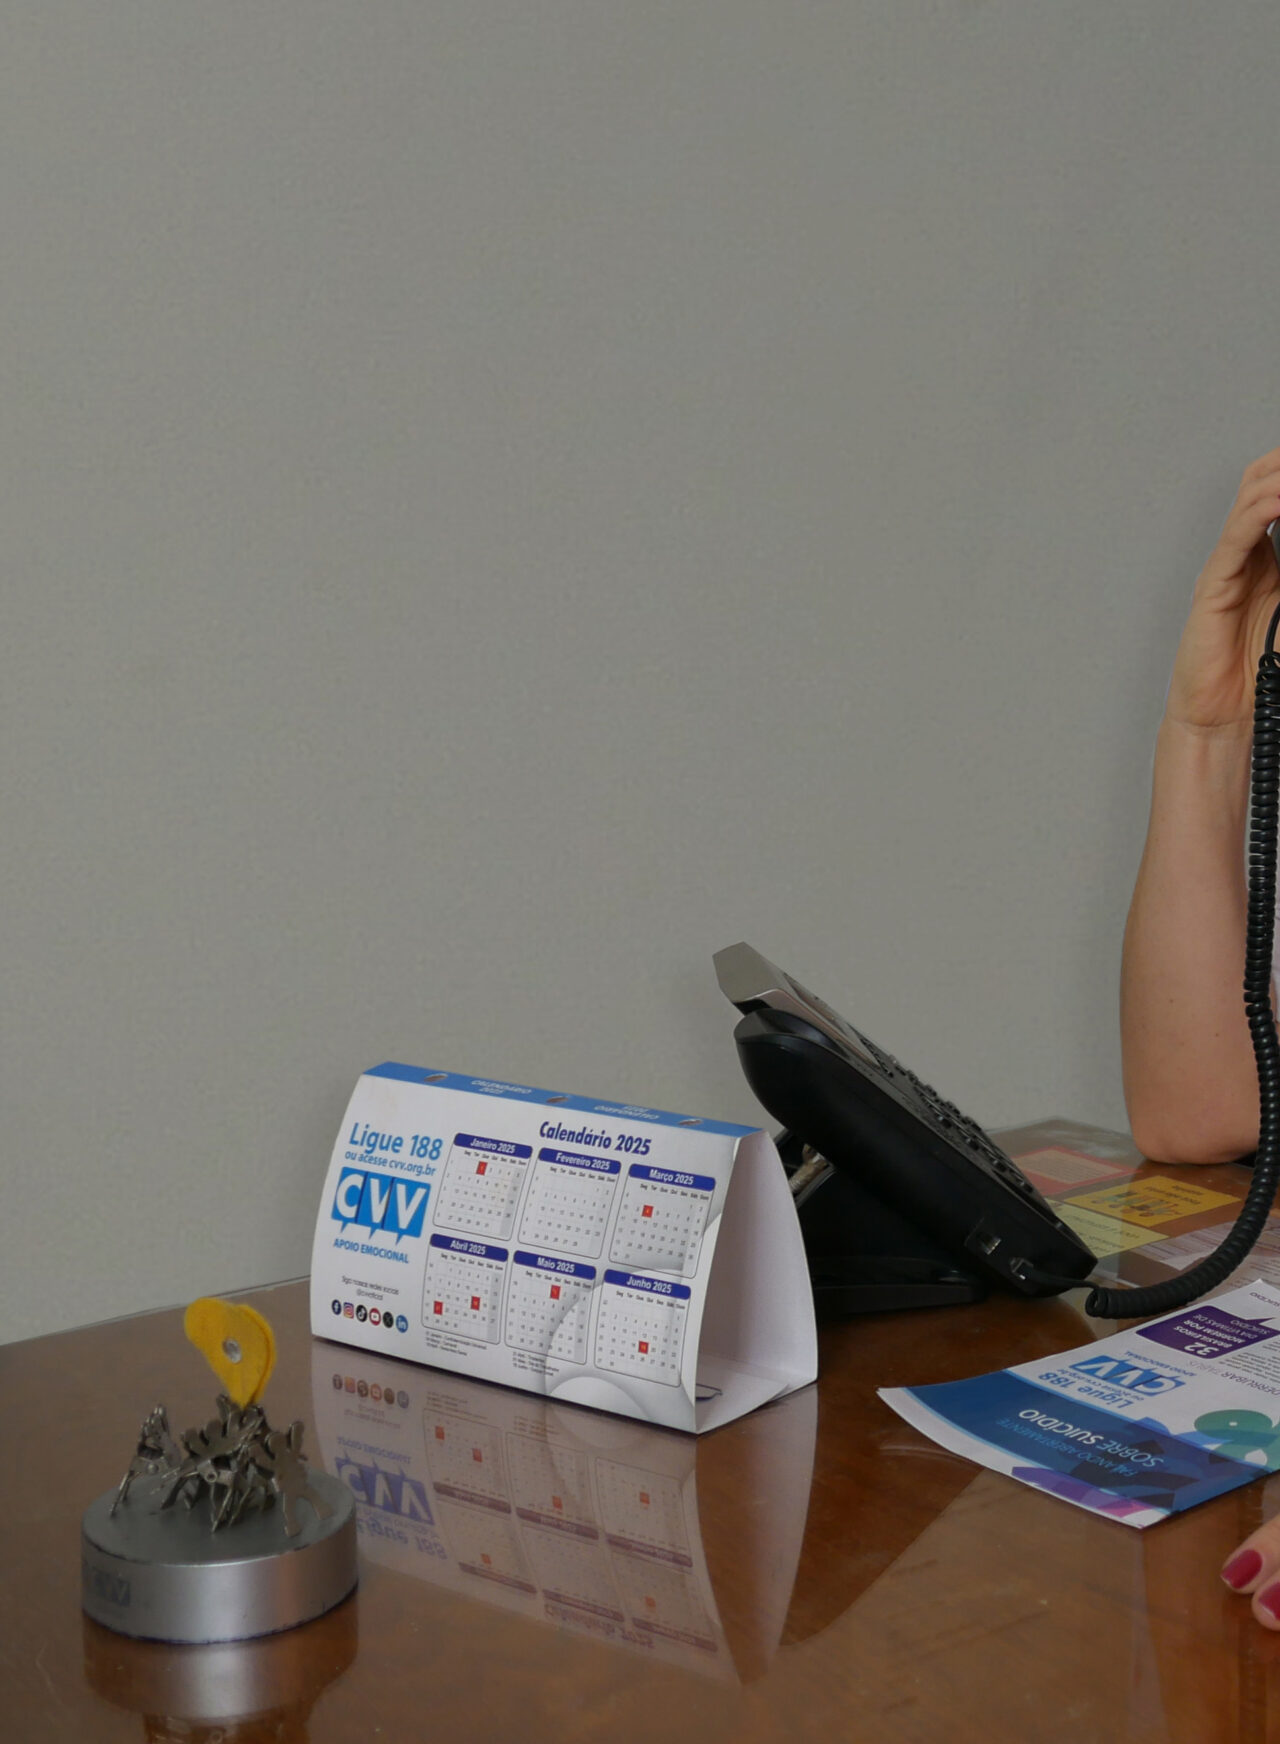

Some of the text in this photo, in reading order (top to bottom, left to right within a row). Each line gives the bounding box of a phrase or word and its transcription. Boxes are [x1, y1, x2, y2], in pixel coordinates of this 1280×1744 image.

[348, 1122, 443, 1161] Ligue 188
[470, 1138, 516, 1154] Janeiro 2025
[539, 1121, 652, 1156] Calendário 2025
[345, 1150, 437, 1177] ou acesse cvv.org.br
[555, 1152, 611, 1171] Fevereiro 2025
[649, 1169, 694, 1185] Março 2025
[335, 1173, 428, 1230] CVV
[333, 1238, 410, 1264] APOIO EMOCIONAL
[450, 1240, 486, 1255] Abril 2025
[537, 1257, 575, 1273] Maio 2025
[626, 1276, 672, 1294] Junho 2025
[1184, 1341, 1219, 1356] 32
[1075, 1360, 1177, 1393] CVV
[1038, 1371, 1134, 1409] Ligue 188
[1018, 1408, 1165, 1468] SOBRE SUICÍDIO
